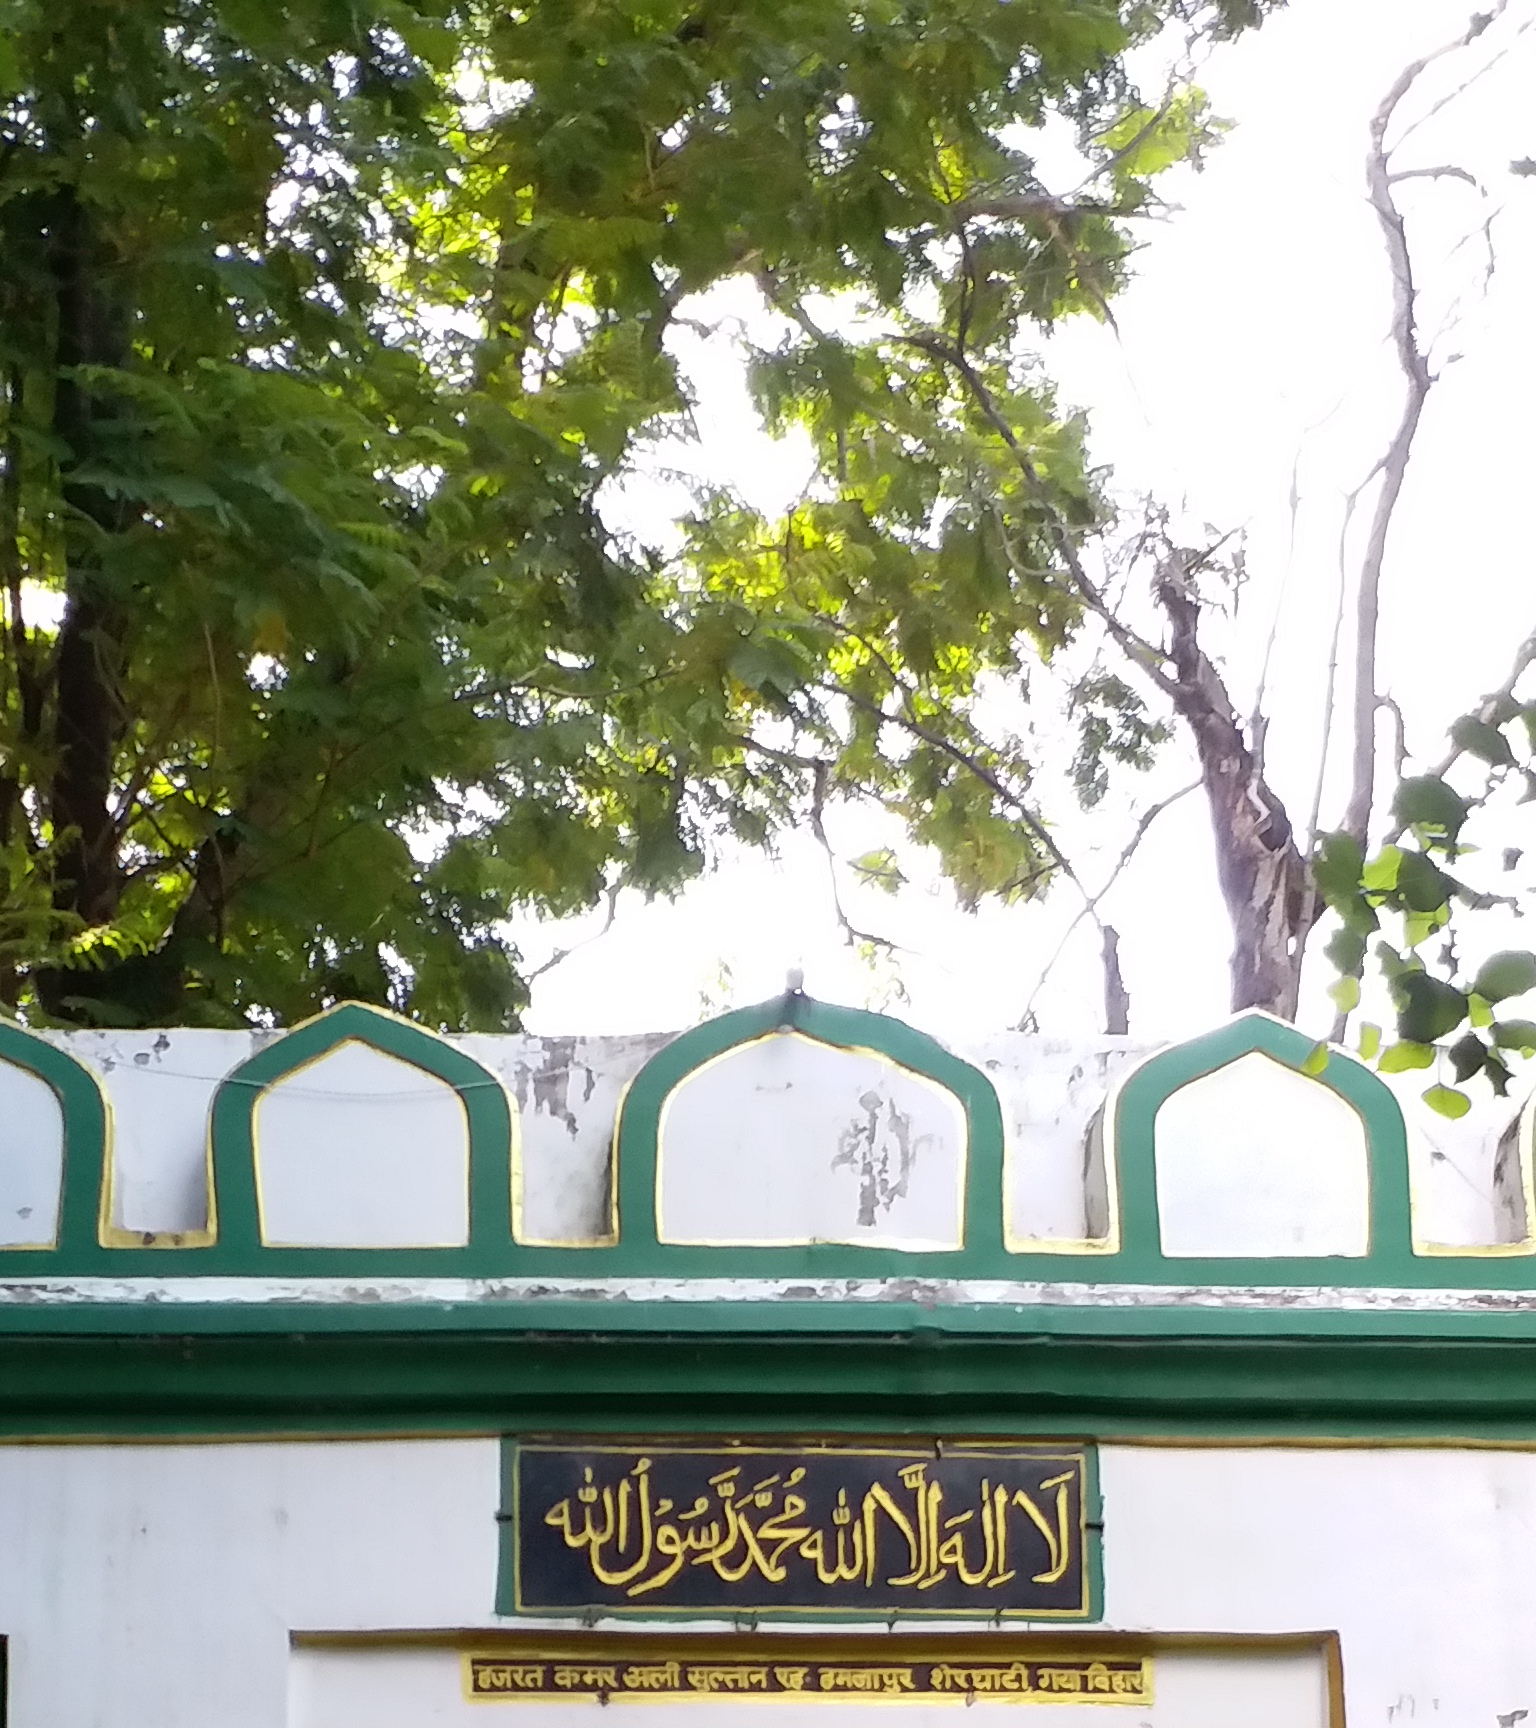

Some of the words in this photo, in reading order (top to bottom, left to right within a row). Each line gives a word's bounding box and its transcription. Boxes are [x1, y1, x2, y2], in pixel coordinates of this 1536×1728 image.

[474, 1664, 546, 1689] हजरत
[554, 1665, 618, 1689] कमर
[622, 1661, 681, 1689] अली
